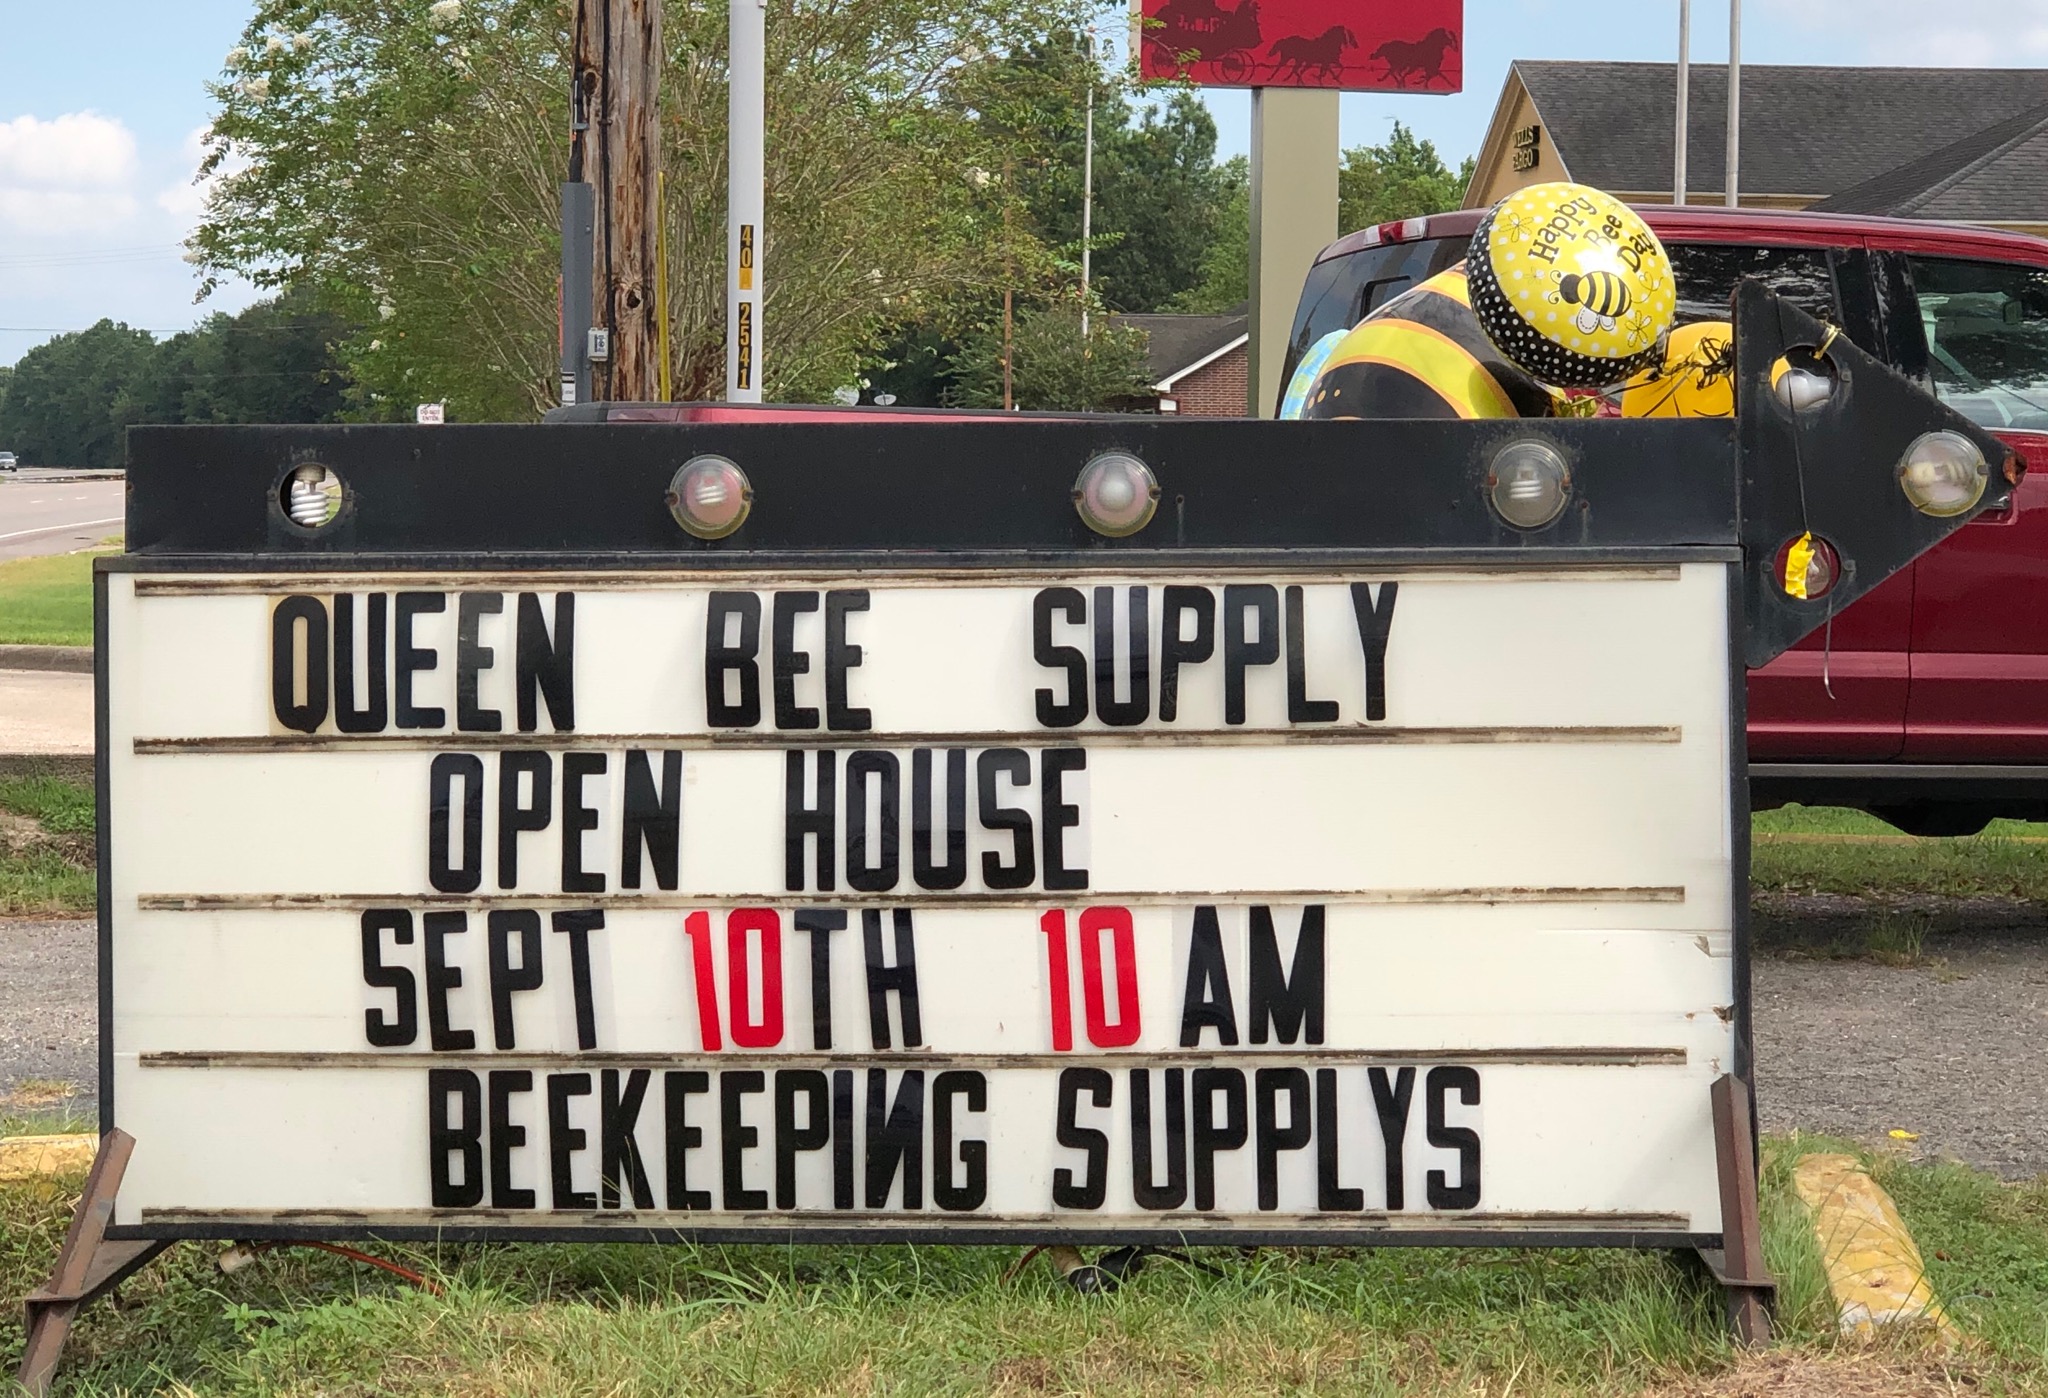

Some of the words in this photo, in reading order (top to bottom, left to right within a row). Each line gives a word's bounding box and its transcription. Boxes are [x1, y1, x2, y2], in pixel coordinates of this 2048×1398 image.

[740, 226, 753, 267] 40
[1528, 197, 1597, 265] Happy
[1583, 214, 1623, 247] Bee
[1617, 226, 1658, 273] Day
[738, 303, 751, 388] 2541
[272, 592, 574, 733] QUEEN
[705, 589, 872, 731] BEE
[1033, 581, 1399, 727] SUPPLY
[429, 750, 683, 893] OPEN
[786, 748, 1089, 892] HOUSE
[361, 908, 605, 1051] SEPT
[685, 908, 922, 1051] 10TH
[1040, 906, 1141, 1051] 10
[1179, 905, 1325, 1046] AM
[429, 1069, 987, 1211] BEEKEEPING
[1053, 1066, 1480, 1211] SUPPLYS
